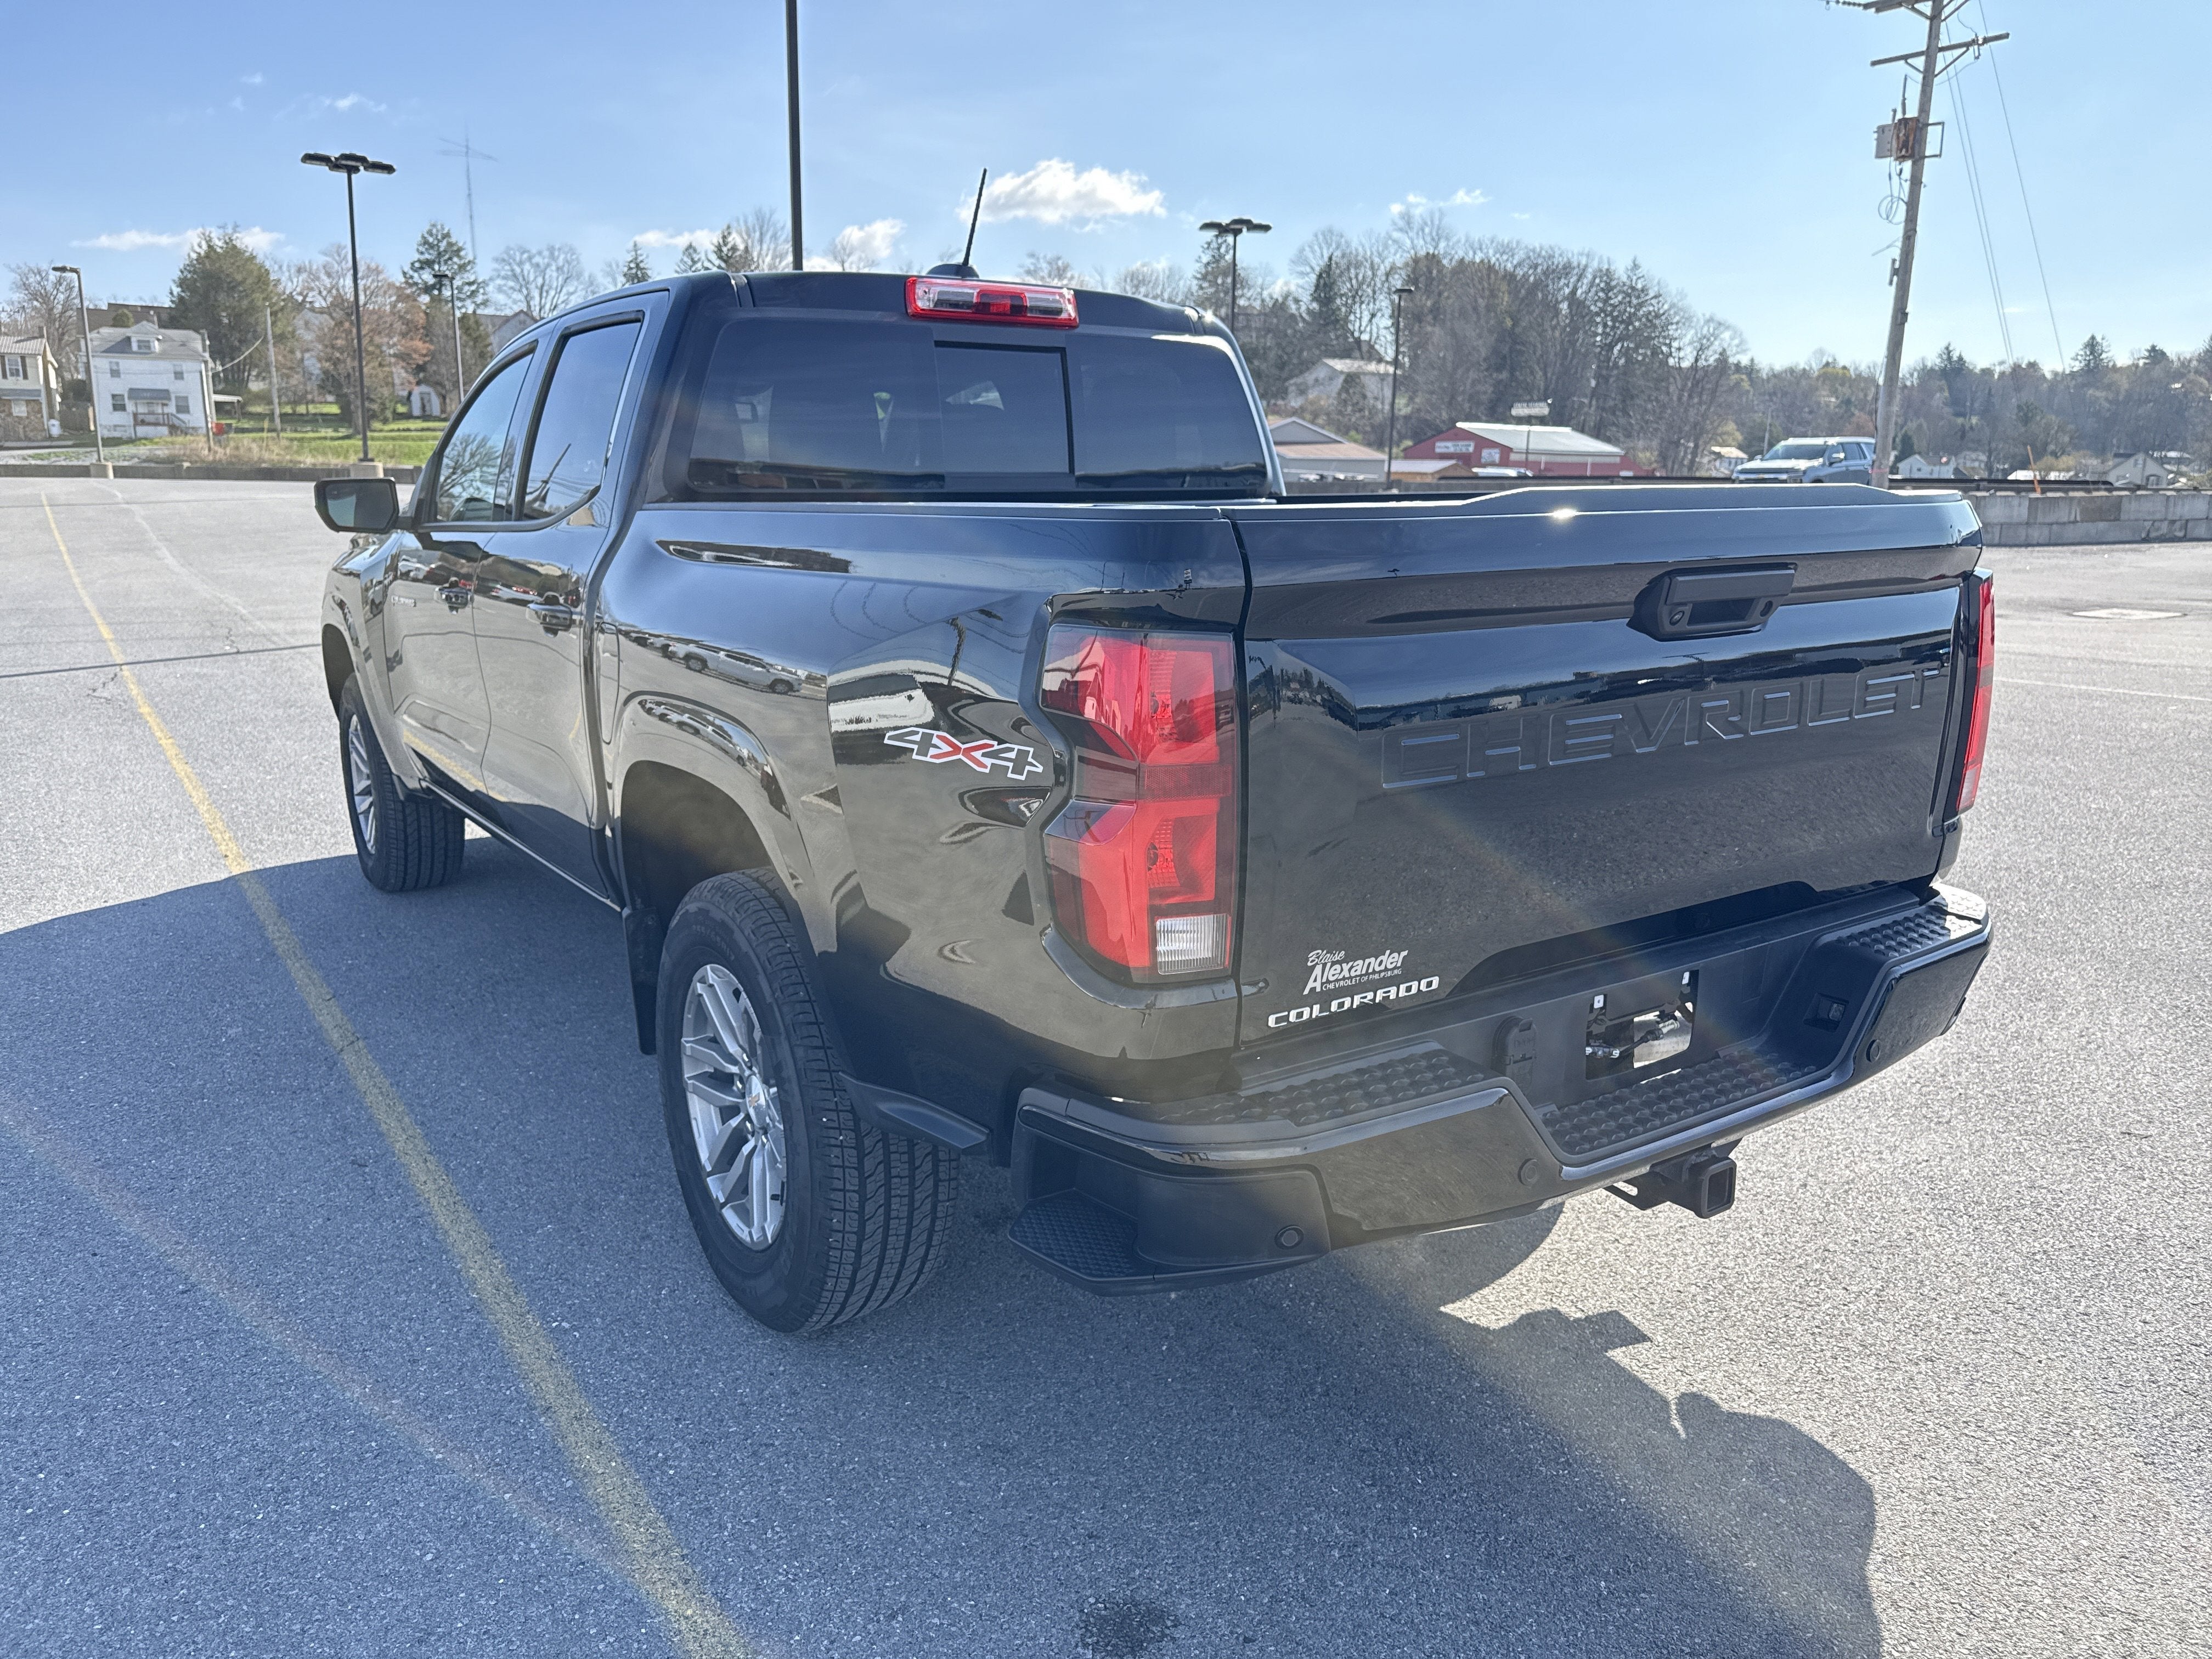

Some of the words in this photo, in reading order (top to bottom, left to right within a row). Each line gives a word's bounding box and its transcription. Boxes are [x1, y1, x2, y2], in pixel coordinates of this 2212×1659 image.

[1382, 661, 1941, 788] CHEVROLET
[1303, 950, 1409, 995] Alexander
[1307, 950, 1345, 966] Blaise
[1323, 977, 1359, 991] CHEVROLET
[1369, 968, 1402, 980] PHILIPSBURG
[1268, 976, 1440, 1028] COLORADO
